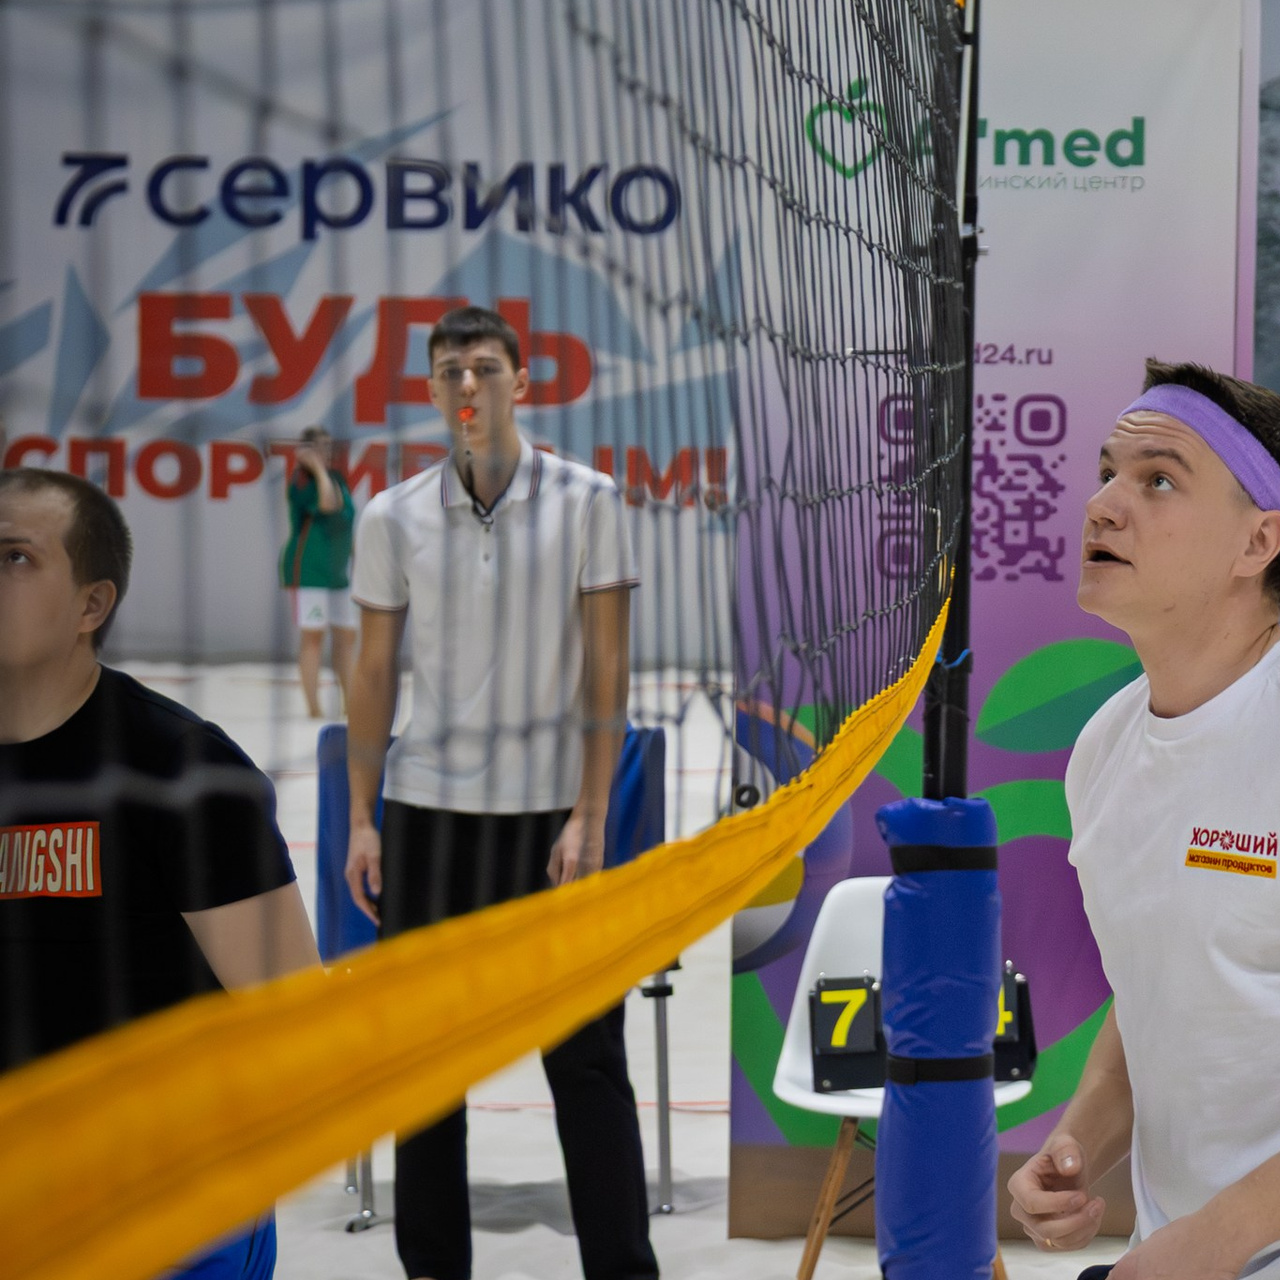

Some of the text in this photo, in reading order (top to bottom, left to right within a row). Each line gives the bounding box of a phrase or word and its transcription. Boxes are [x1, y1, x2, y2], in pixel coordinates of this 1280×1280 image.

[1073, 174, 1146, 192] центр
[1189, 827, 1278, 857] ХОРОШИЙ
[1188, 854, 1273, 874] магазин продуктов
[820, 988, 868, 1048] 7
